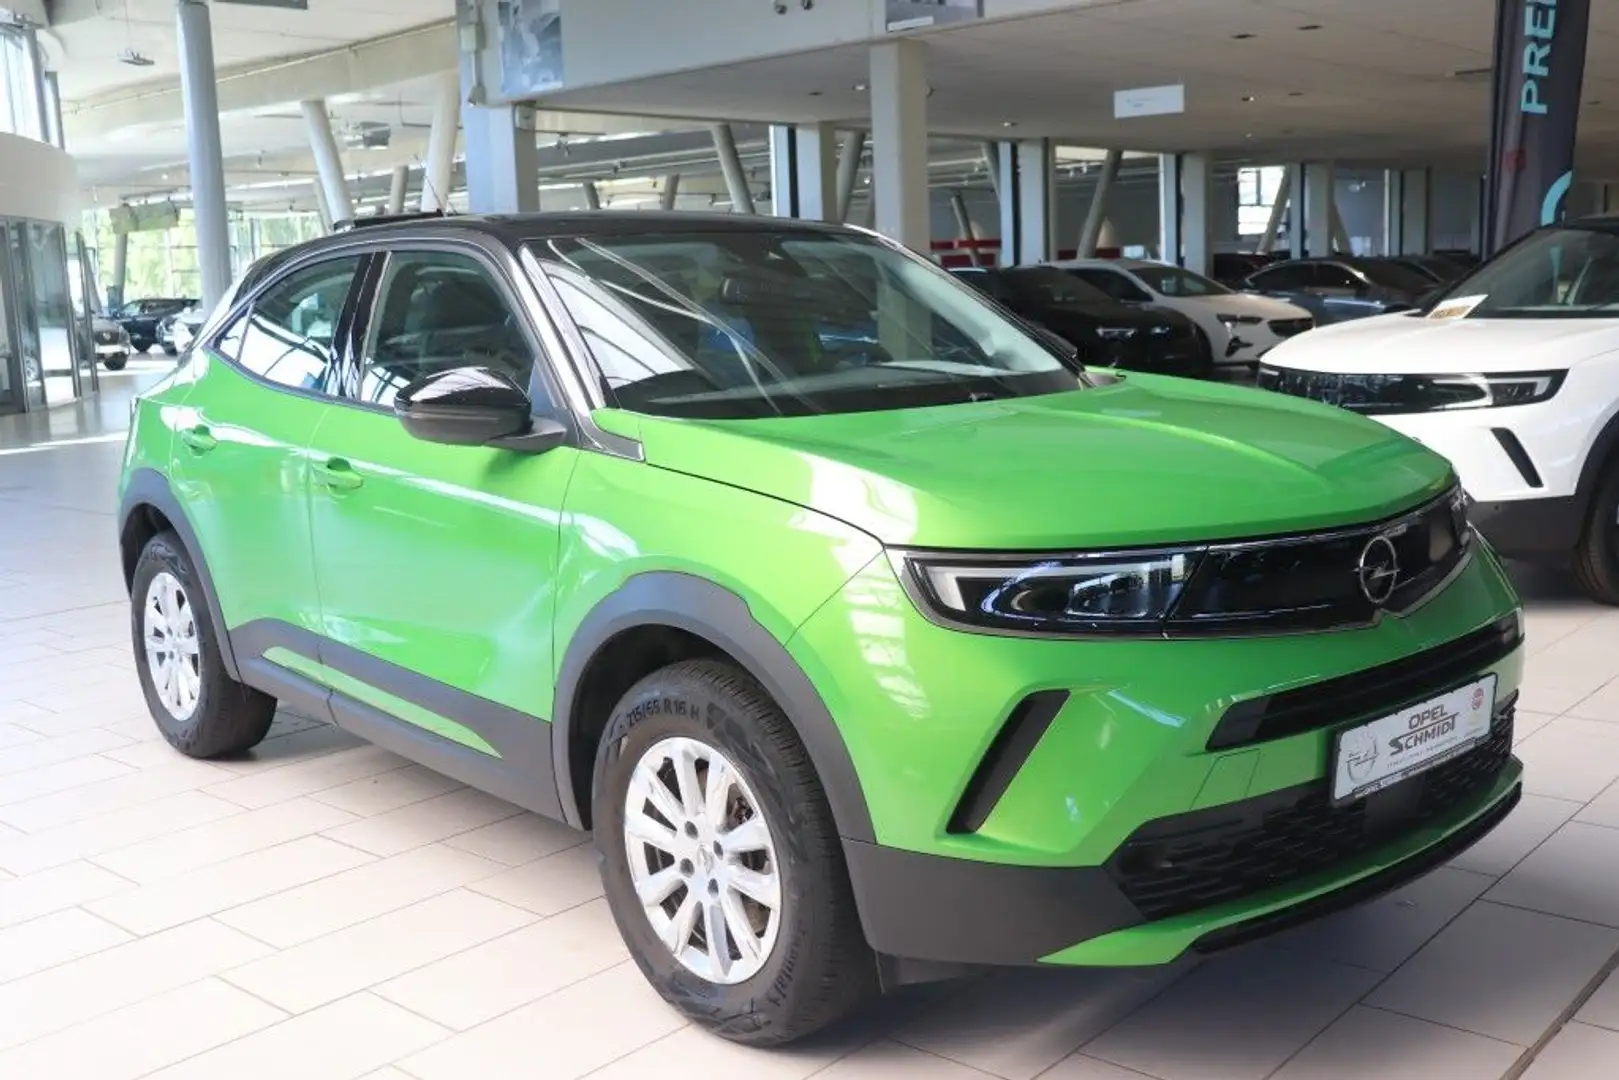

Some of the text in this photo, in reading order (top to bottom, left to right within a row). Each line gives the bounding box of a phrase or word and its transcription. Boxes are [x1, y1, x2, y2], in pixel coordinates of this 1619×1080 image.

[1521, 0, 1557, 114] PRE
[1388, 712, 1460, 756] SCHMIDT
[1408, 704, 1448, 730] OPEL
